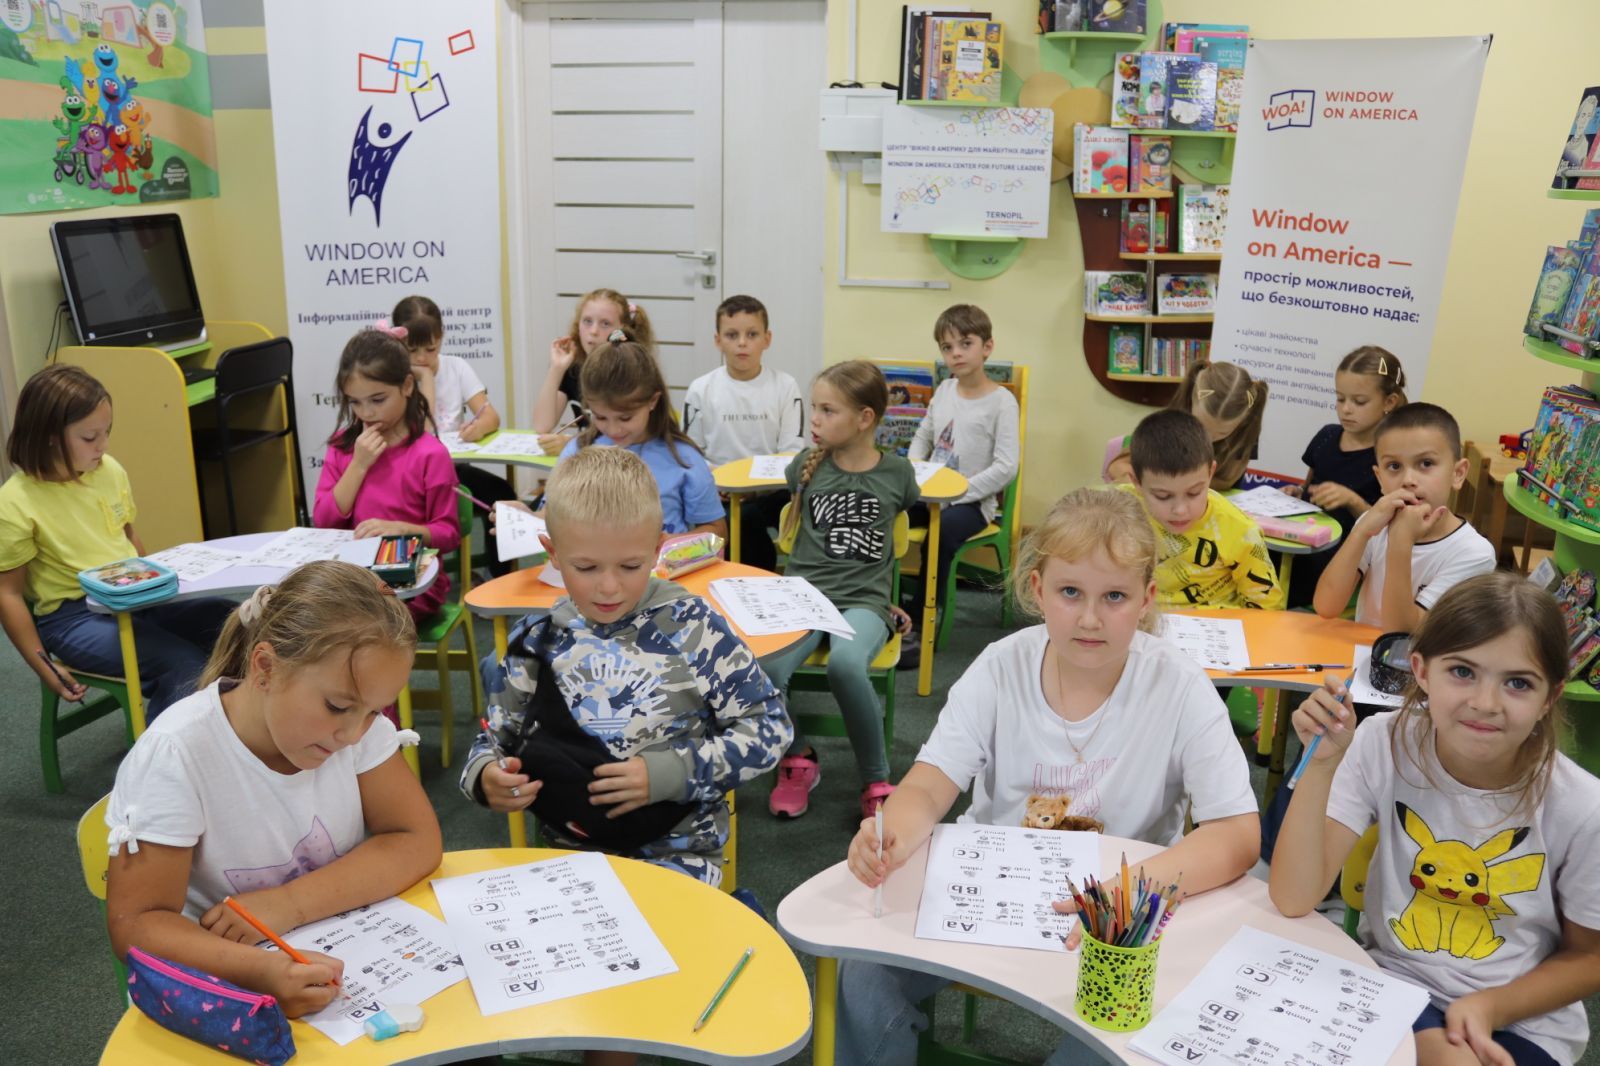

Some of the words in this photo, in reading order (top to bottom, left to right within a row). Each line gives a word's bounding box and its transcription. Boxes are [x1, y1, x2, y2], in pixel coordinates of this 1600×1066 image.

[1326, 90, 1394, 103] WINDOW
[1262, 101, 1306, 121] WOA!
[1323, 108, 1344, 118] ON
[1350, 108, 1418, 120] AMERICA
[983, 146, 1018, 154] МАЙБУТНІХ
[986, 211, 1023, 219] TERNOPIL
[1252, 208, 1350, 234] Window
[305, 242, 405, 261] WINDOW
[413, 241, 445, 258] ON
[1248, 242, 1276, 258] on
[1284, 242, 1380, 269] America
[326, 266, 429, 286] AMERICA
[1244, 270, 1301, 288] простір
[1306, 277, 1414, 302] можливостей,
[1241, 290, 1264, 302] що
[1269, 291, 1368, 316] безкоштовно
[1373, 307, 1420, 323] надає:
[457, 308, 492, 318] центр
[1242, 328, 1266, 338] цікаві
[1269, 331, 1318, 345] знайомства
[1240, 343, 1272, 354] сучасні
[1275, 348, 1316, 360] технології
[1238, 358, 1274, 370] ресурси
[1294, 367, 1334, 378] навчання
[1270, 392, 1286, 400] для
[1287, 396, 1328, 409] реалізації
[722, 412, 768, 422] THURSDAY
[812, 492, 880, 524] WILD
[830, 527, 885, 560] ONE
[1294, 968, 1309, 977] city
[1359, 975, 1384, 988] picnic
[1235, 985, 1261, 997] rabbit
[1361, 985, 1380, 995] cow
[1359, 993, 1375, 1001] cap
[1299, 1004, 1319, 1014] crab
[1285, 1010, 1311, 1024] bomb
[1217, 1023, 1237, 1033] park
[1347, 1024, 1364, 1033] box
[1206, 1036, 1225, 1047] arm
[1217, 1032, 1231, 1040] car
[1339, 1032, 1357, 1042] bed
[1262, 1041, 1279, 1052] bag
[1260, 1050, 1274, 1058] cat
